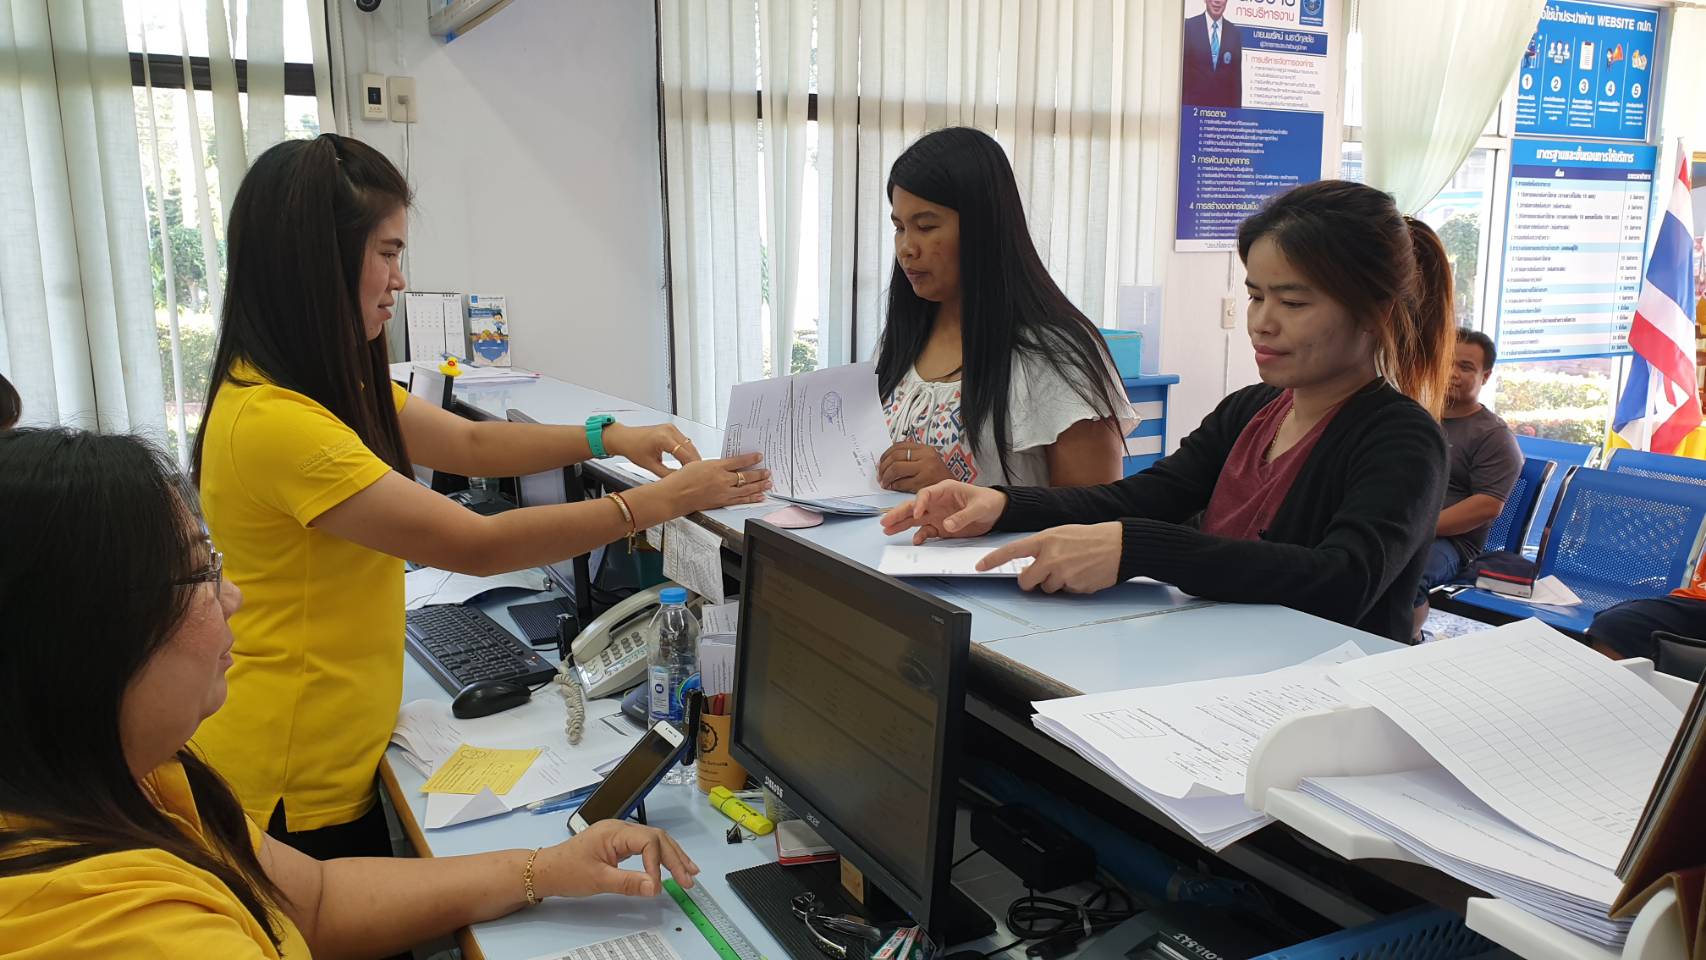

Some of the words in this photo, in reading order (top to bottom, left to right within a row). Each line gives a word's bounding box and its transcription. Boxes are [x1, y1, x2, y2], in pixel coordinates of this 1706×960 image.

[1236, 5, 1295, 22] การบริหารงาน
[1597, 15, 1635, 31] WEBSITE
[1193, 107, 1199, 117] 2
[1191, 154, 1197, 164] 3
[1189, 202, 1195, 210] 4
